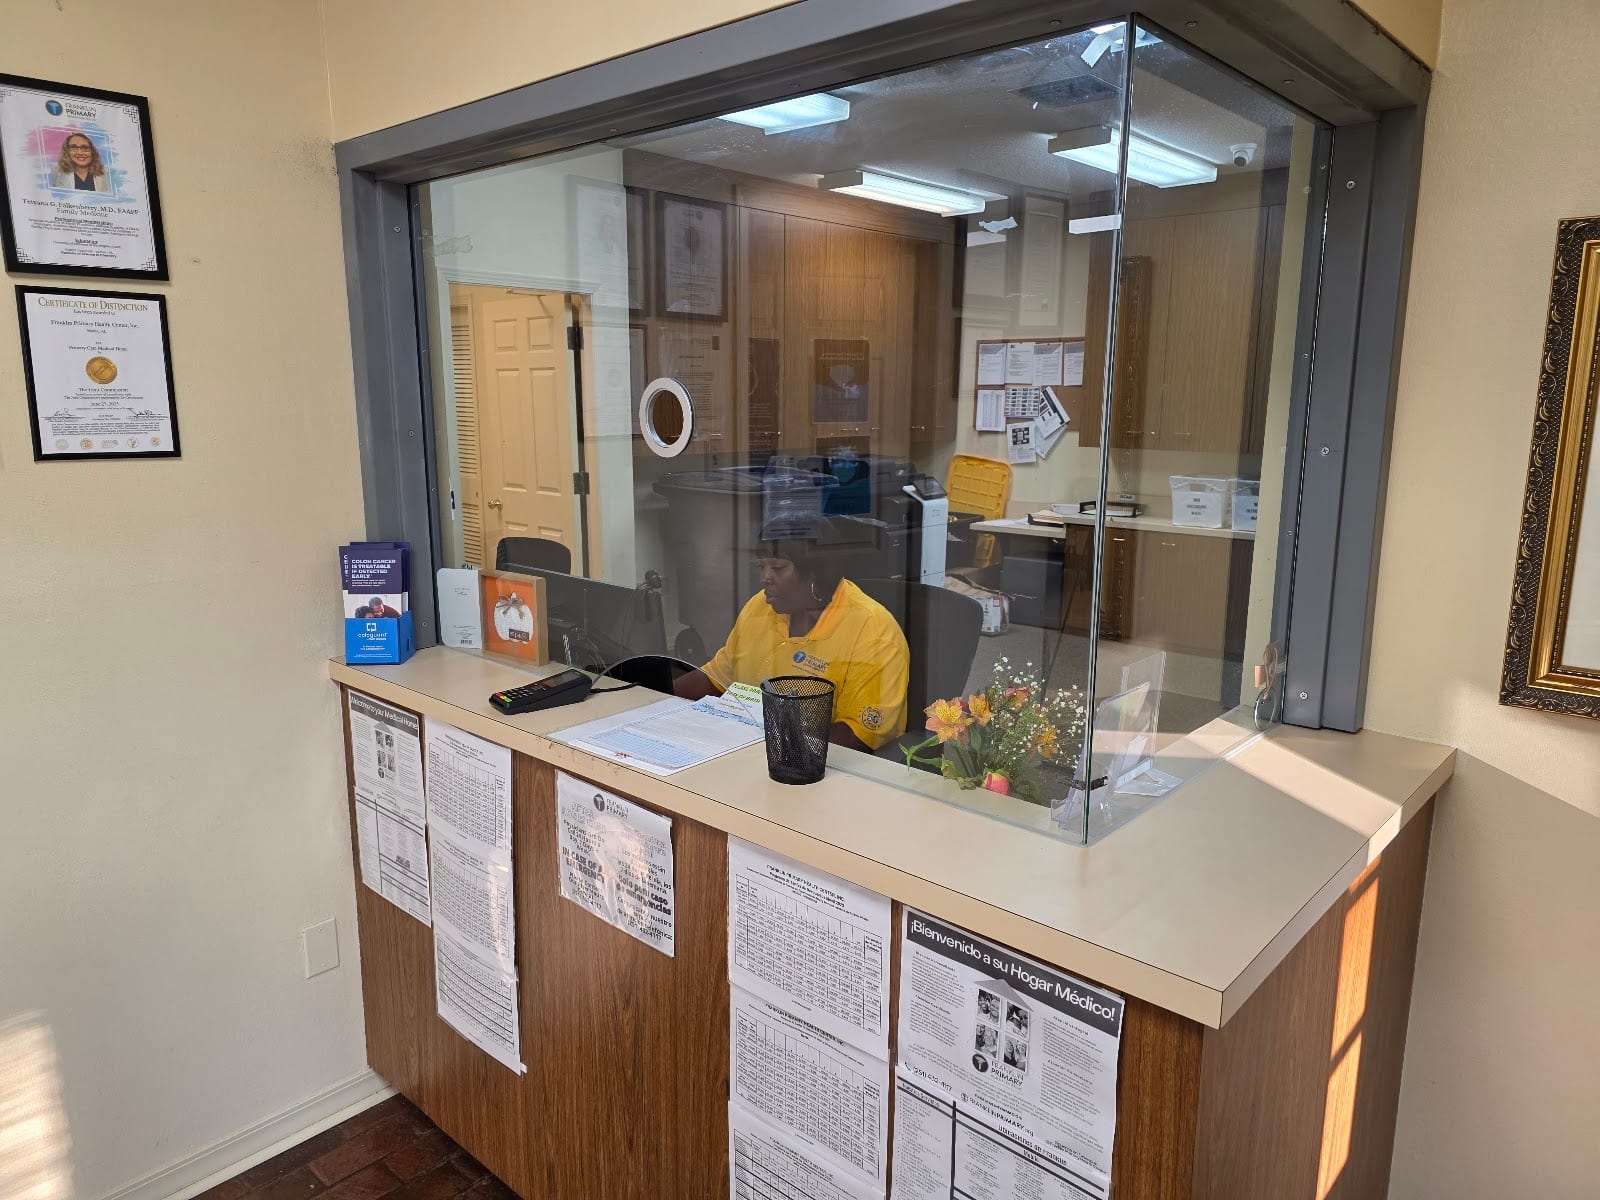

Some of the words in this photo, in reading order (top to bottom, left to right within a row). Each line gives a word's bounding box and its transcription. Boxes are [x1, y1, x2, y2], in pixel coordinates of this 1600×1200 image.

[66, 109, 97, 118] PRIMARY
[57, 208, 78, 216] Family
[38, 296, 87, 309] CERTIFICATE
[89, 301, 99, 309] OF
[100, 300, 149, 312] DISTINCTION
[562, 847, 570, 858] IN
[571, 851, 587, 865] CASE
[587, 858, 597, 870] OF
[566, 857, 605, 884] EMERGENCY
[650, 893, 669, 905] caso
[911, 919, 982, 960] ¡Bienvenido
[982, 951, 992, 965] a
[993, 957, 1009, 974] su
[1010, 963, 1053, 994] Hogar
[1055, 981, 1117, 1022] Médico!
[991, 1067, 1024, 1087] PRIMARY
